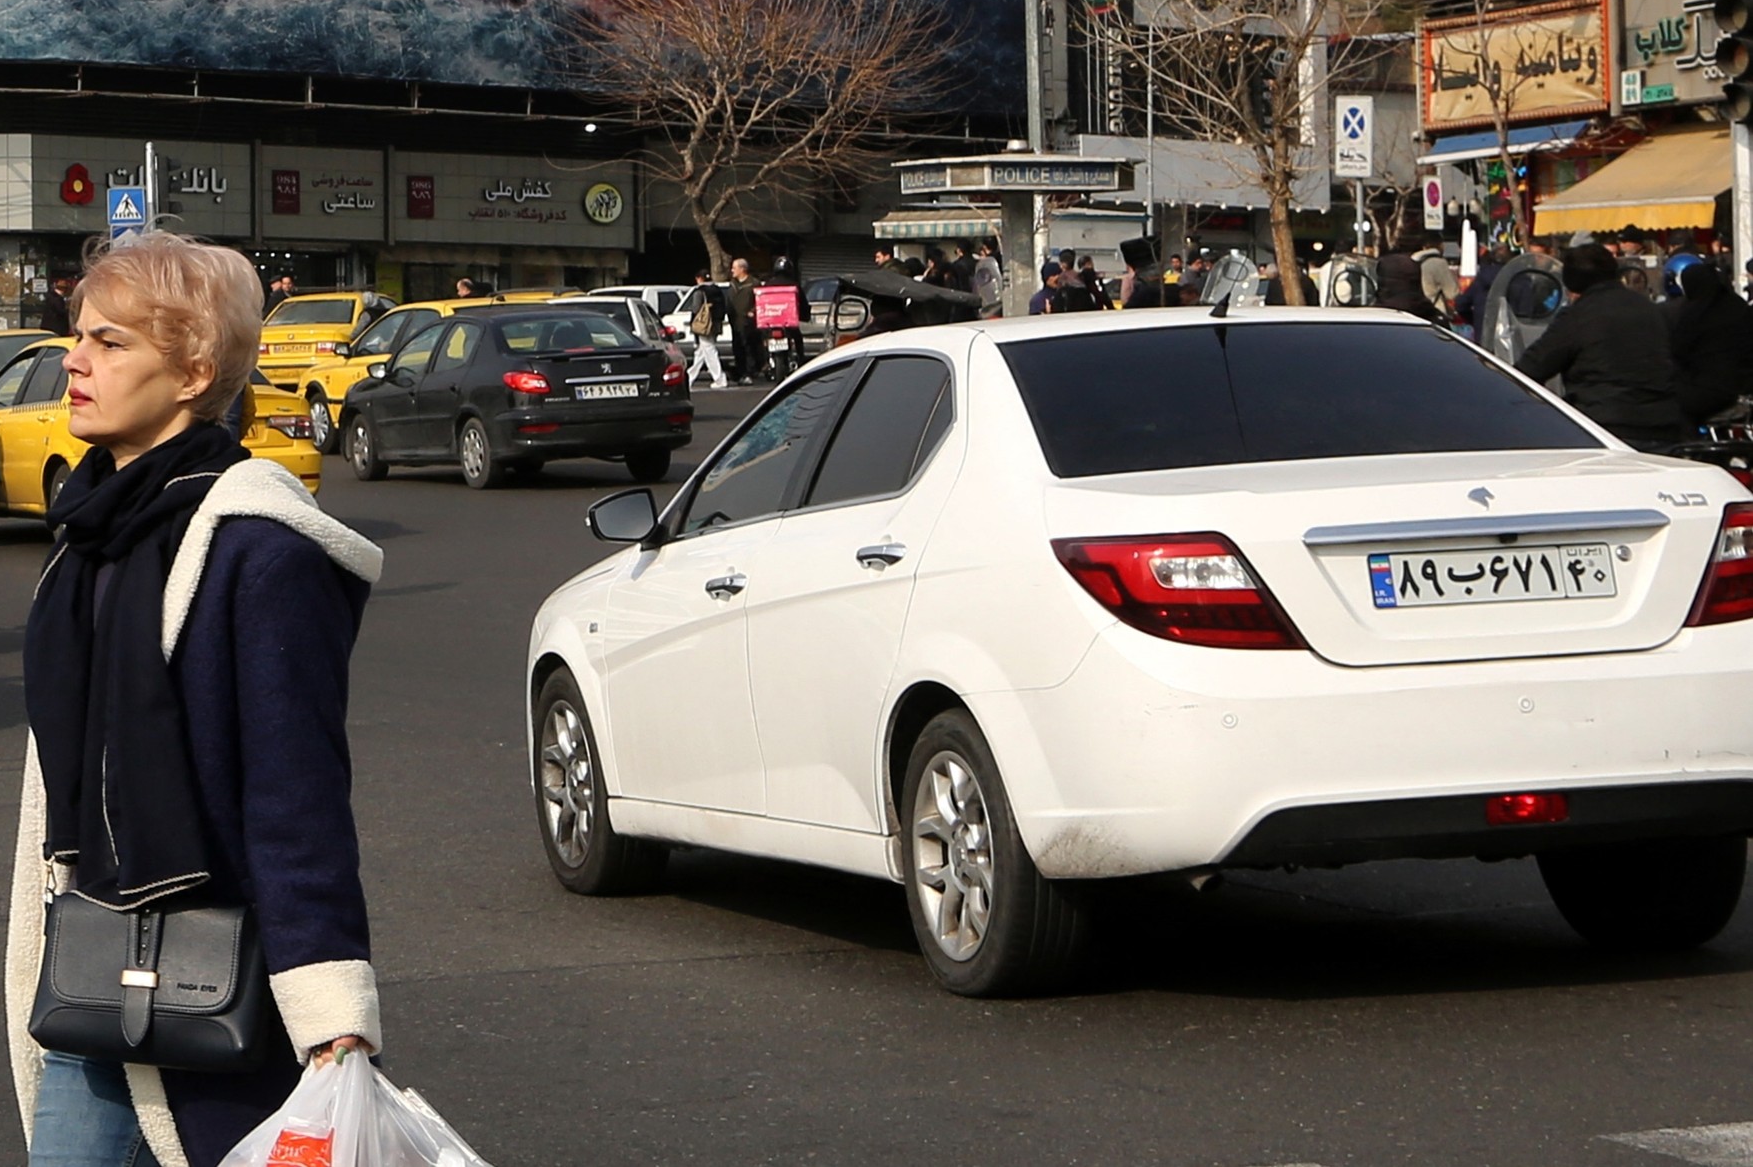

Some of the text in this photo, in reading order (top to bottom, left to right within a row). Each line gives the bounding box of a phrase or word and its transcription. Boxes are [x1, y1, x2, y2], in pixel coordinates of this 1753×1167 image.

[1635, 17, 1684, 62] کلاب
[994, 167, 1050, 184] POLICE
[485, 178, 552, 203] کفش ملی
[323, 192, 375, 213] ساعتی
[1567, 558, 1606, 593] ۴۰
[1376, 597, 1395, 605] IRAN
